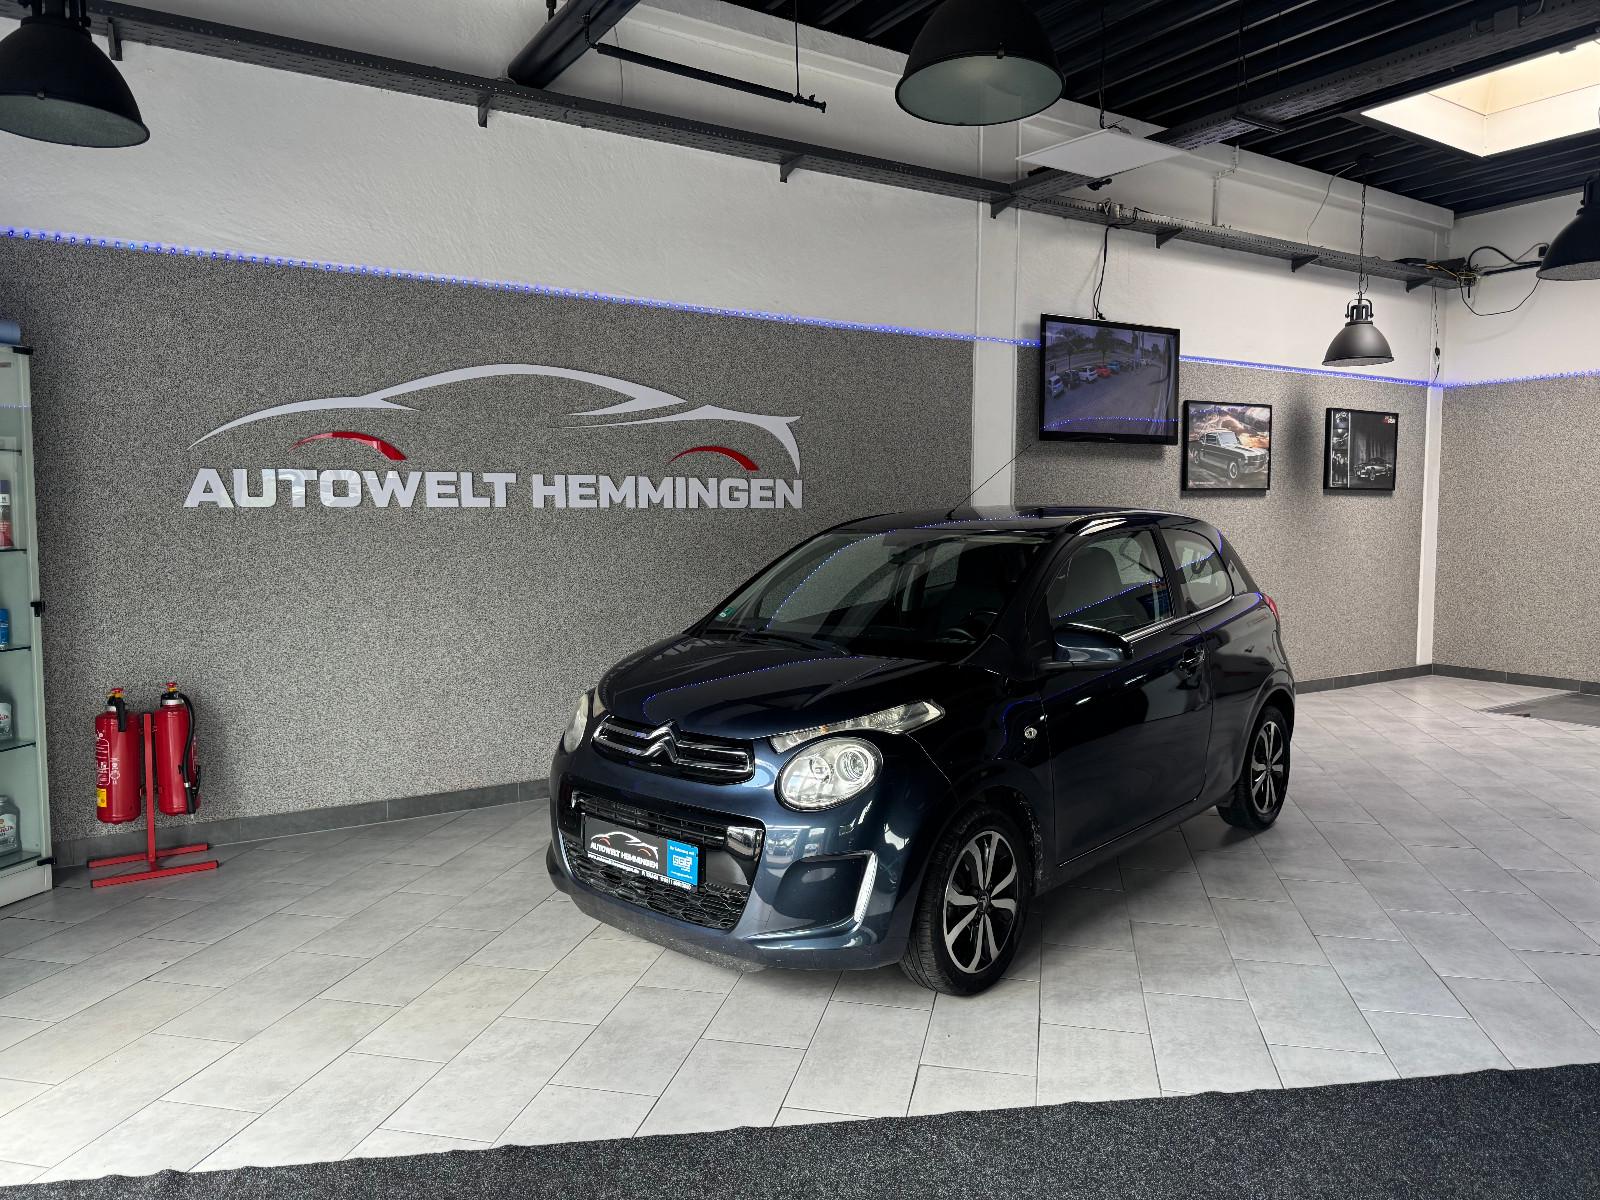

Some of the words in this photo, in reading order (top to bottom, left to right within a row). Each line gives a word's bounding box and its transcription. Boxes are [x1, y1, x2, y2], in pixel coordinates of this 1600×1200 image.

[183, 468, 516, 508] AUTOWELT
[532, 474, 802, 509] HEMMINGEN
[590, 842, 620, 857] AUTOWELT
